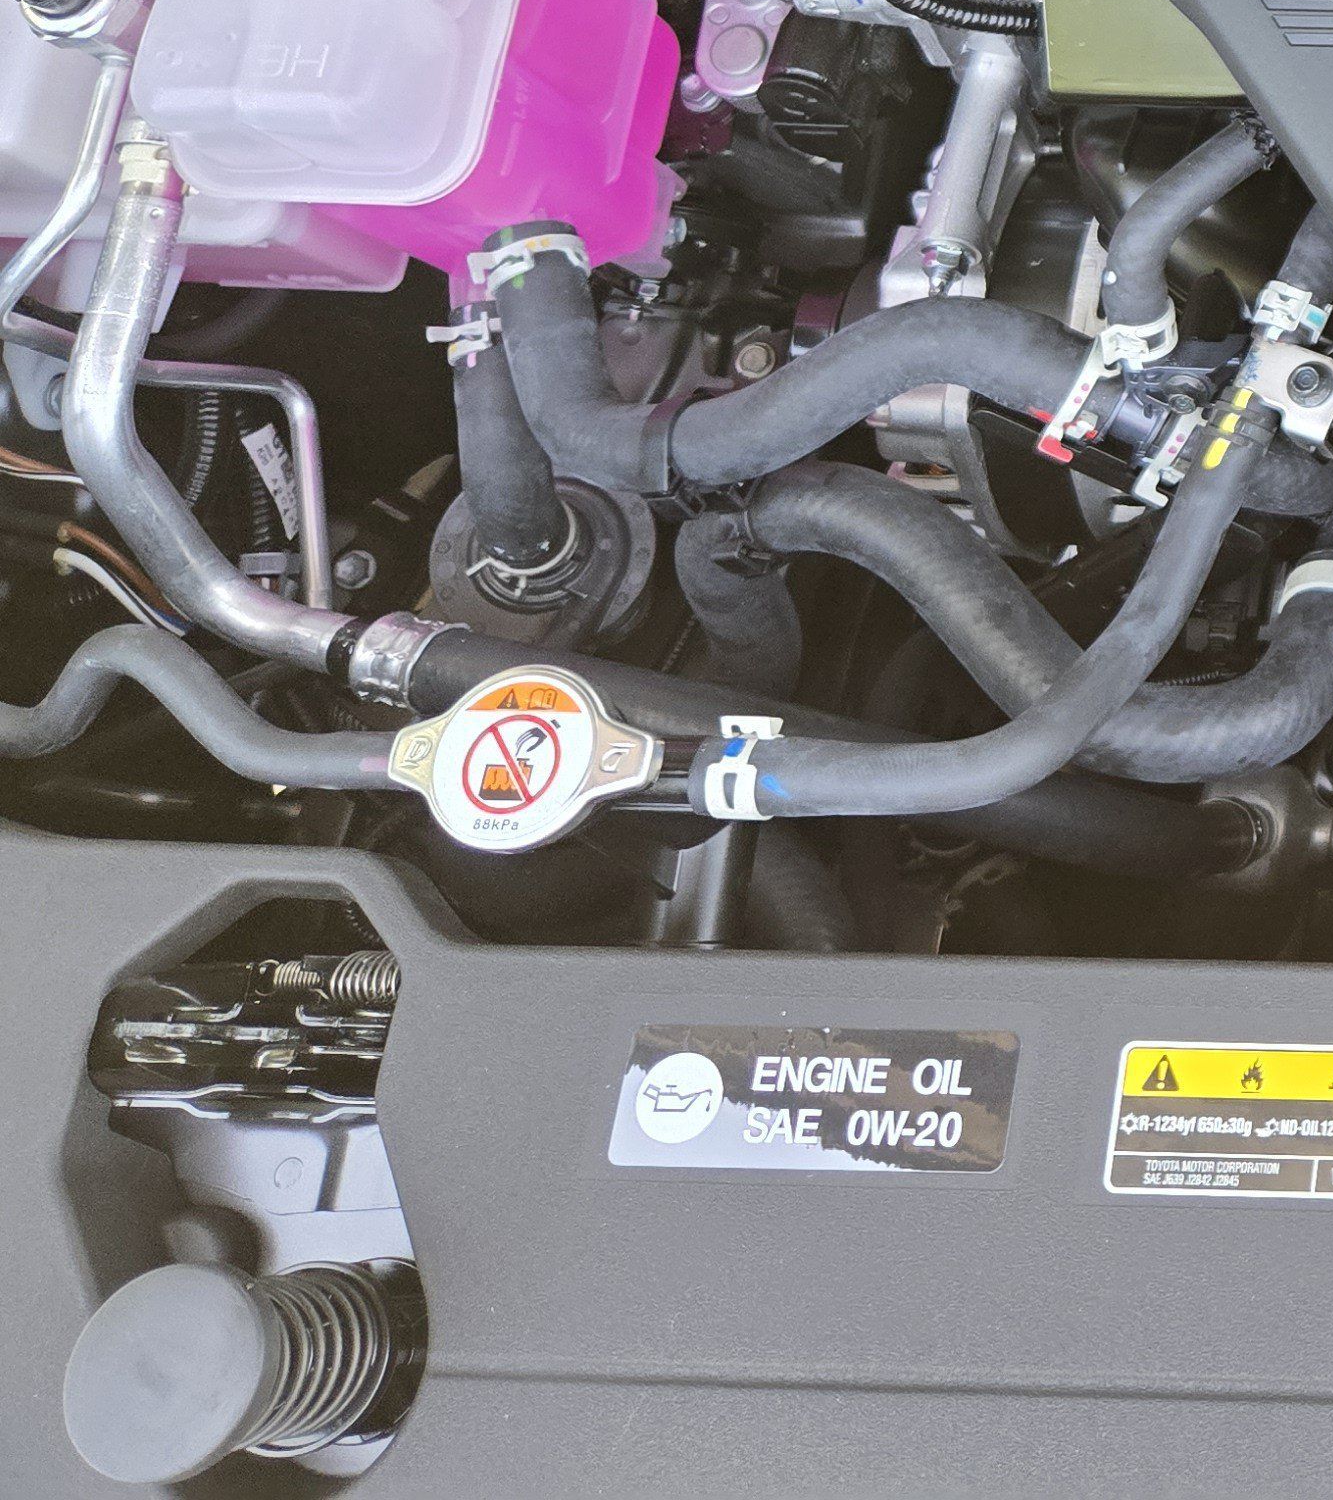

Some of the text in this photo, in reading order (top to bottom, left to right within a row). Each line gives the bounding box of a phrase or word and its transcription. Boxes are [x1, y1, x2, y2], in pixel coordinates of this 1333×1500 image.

[472, 818, 520, 832] 88kPa
[750, 1055, 973, 1096] ENGINE OIL
[742, 1106, 963, 1148] SAE 0W-20
[1145, 1159, 1280, 1175] TOYOTA MOTOR CORPORATION
[1143, 1173, 1161, 1185] SAE
[1162, 1174, 1184, 1186] J639
